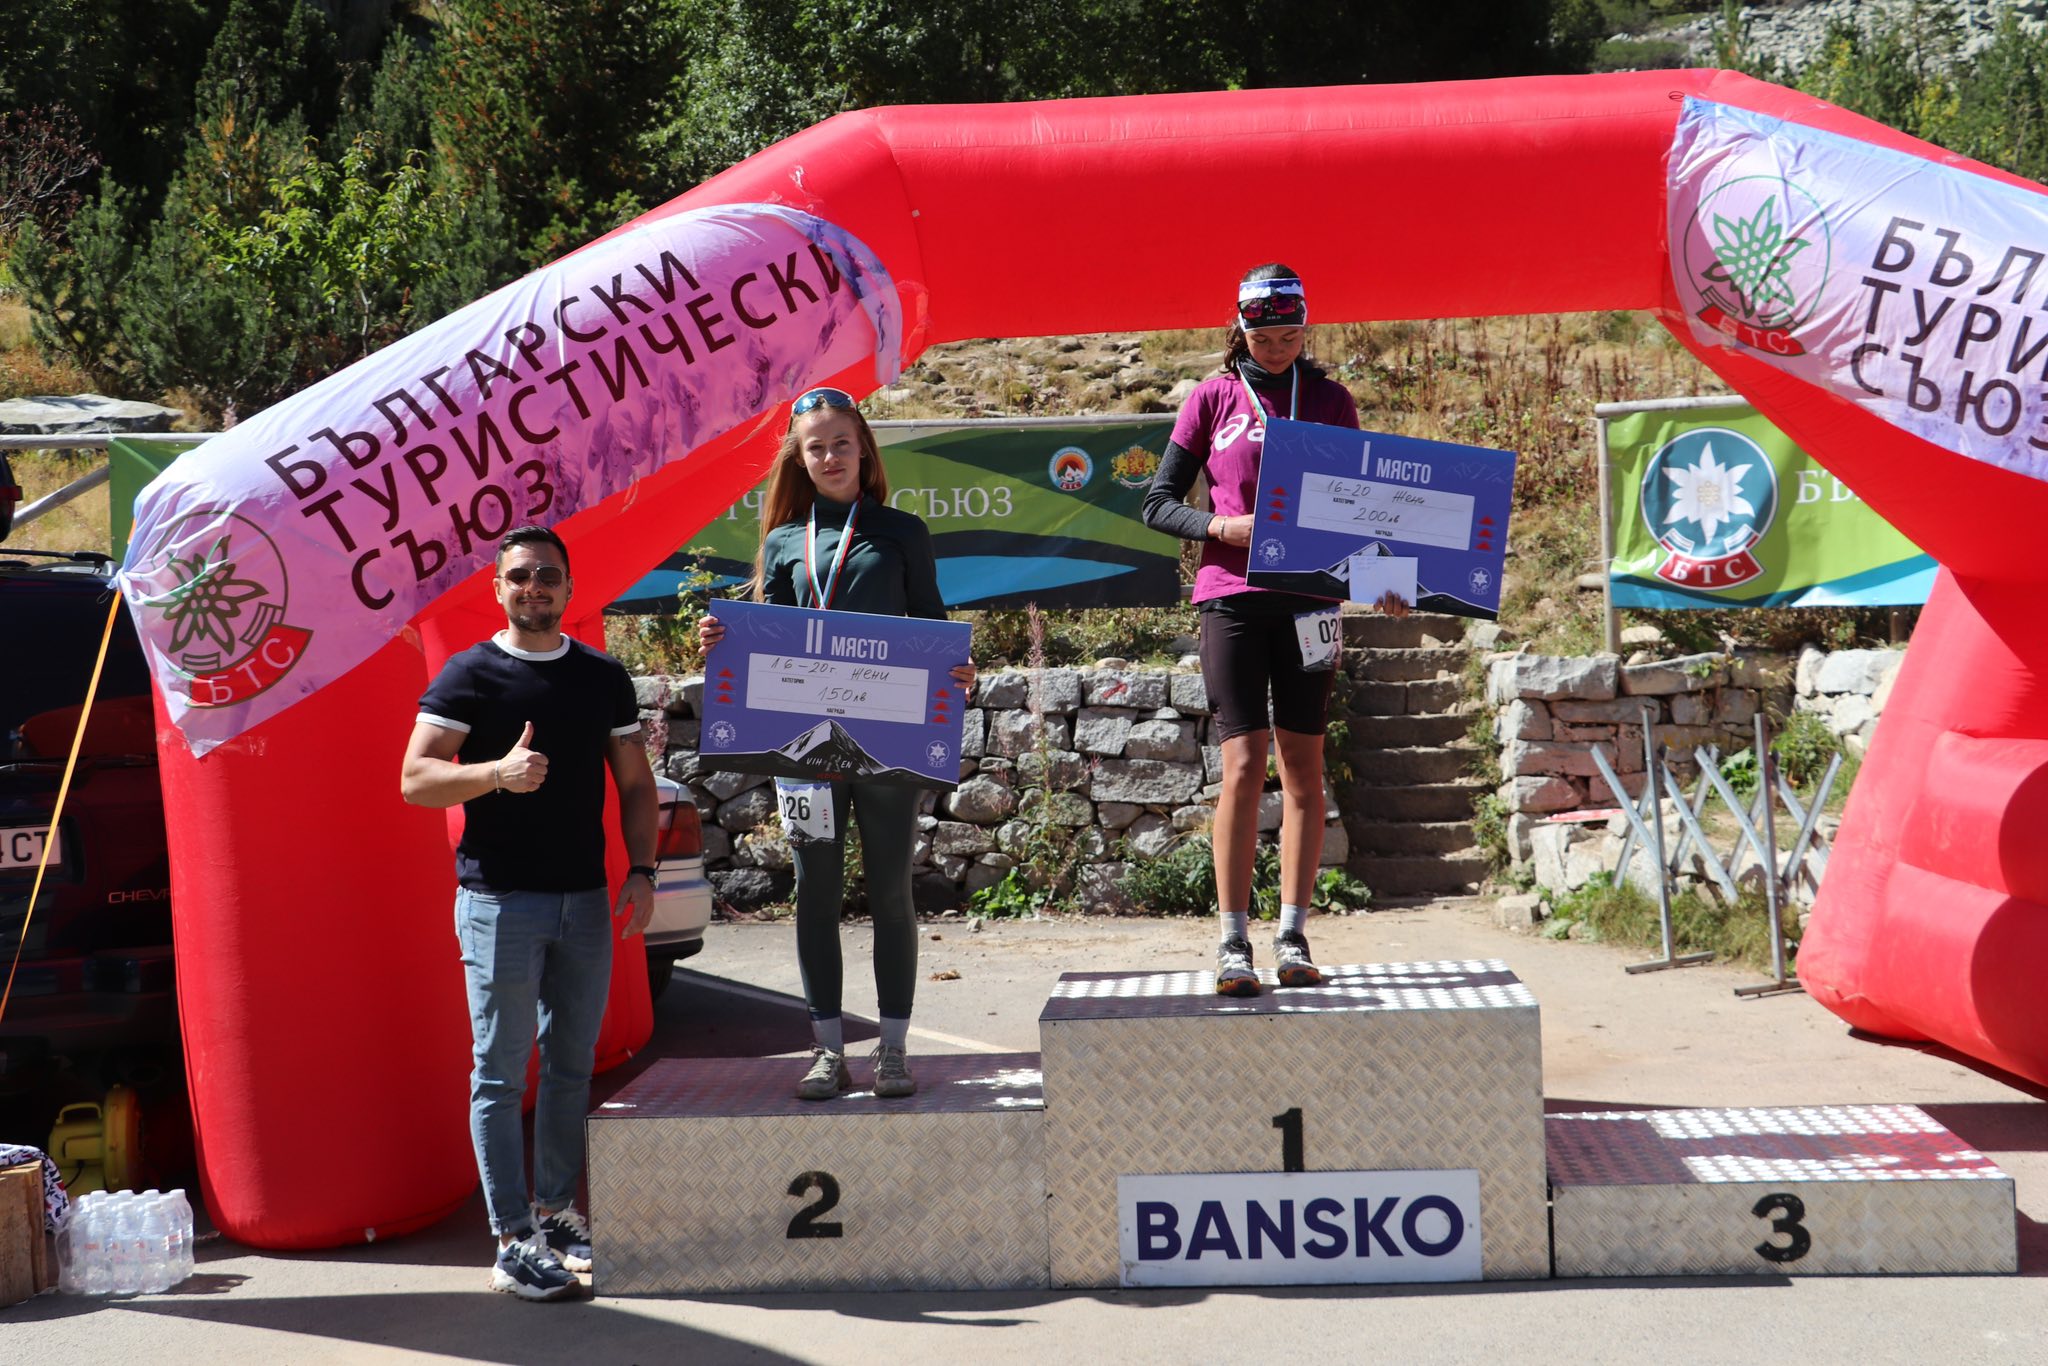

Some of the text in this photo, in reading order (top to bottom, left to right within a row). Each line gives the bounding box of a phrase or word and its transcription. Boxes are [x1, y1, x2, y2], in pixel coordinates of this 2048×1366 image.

[1718, 314, 1790, 354] БТС
[265, 250, 702, 501] БЪЛГАРСКИ
[301, 242, 842, 553] ТУРИСТИЧЕСКИ
[890, 486, 1013, 518] СЪЮЗ
[1327, 479, 1371, 497] 16-20
[1376, 457, 1432, 484] МЯСТО
[350, 458, 556, 612] СЪЮЗ
[1669, 558, 1747, 585] БТС
[831, 635, 889, 661] МЯСТО
[1318, 618, 1342, 644] 02
[207, 637, 295, 705] БТС
[1272, 1107, 1305, 1172] 1
[786, 1169, 843, 1239] 2
[1135, 1194, 1465, 1261] BANSKO
[1751, 1193, 1811, 1264] 3
